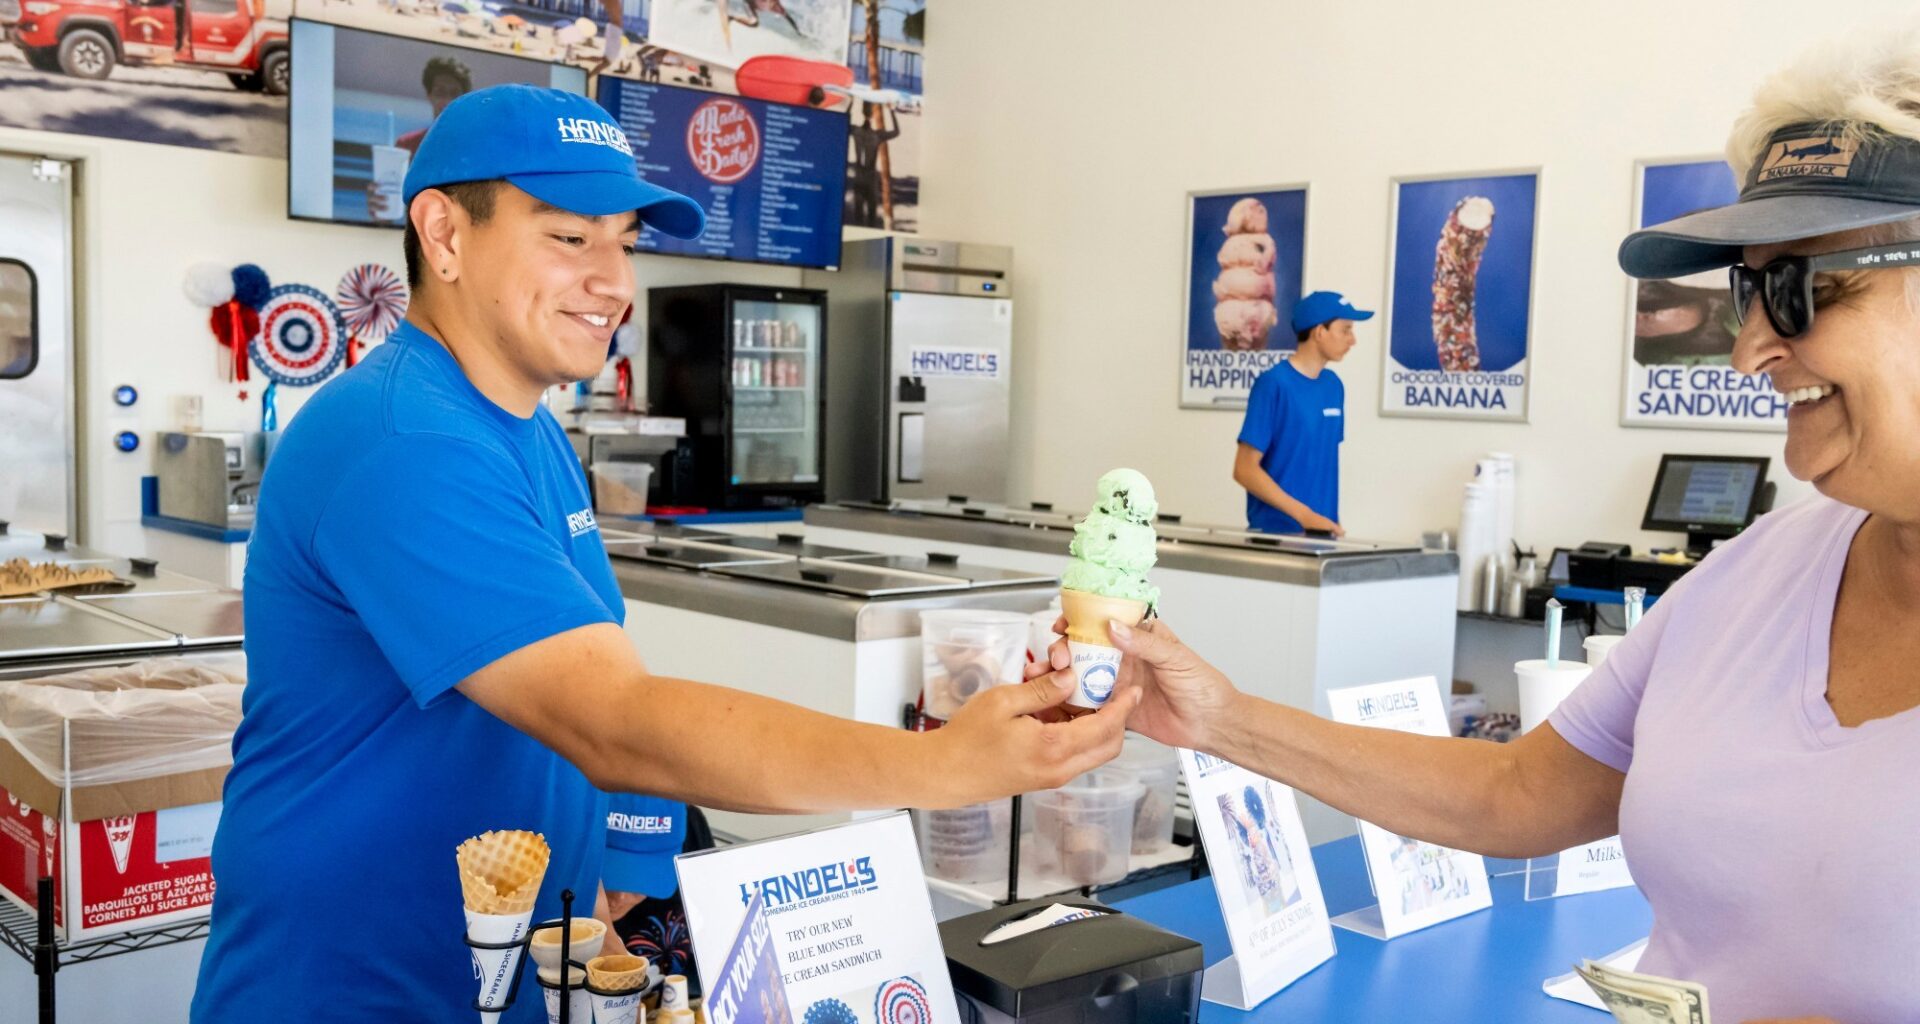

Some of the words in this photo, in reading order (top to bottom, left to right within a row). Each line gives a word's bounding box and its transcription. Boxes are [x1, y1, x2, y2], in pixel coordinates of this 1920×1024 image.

[1189, 352, 1234, 367] HAND
[1239, 352, 1294, 368] PACKE
[1391, 371, 1462, 385] CHOCOLATE
[1465, 374, 1525, 386] COVERED
[1648, 369, 1683, 390] ICE
[1405, 386, 1507, 409] BANANA
[1638, 391, 1789, 418] SANDWICH
[1585, 846, 1625, 863] Milks
[123, 879, 171, 897] JACKETED
[174, 872, 207, 888] SUGAR
[84, 894, 148, 915] BARQUILLOS
[151, 891, 163, 902] DE
[798, 899, 808, 909] ICE
[808, 895, 831, 907] CREAM
[831, 890, 849, 901] SINCE
[850, 886, 866, 897] 1945
[88, 906, 136, 925] CORNETS
[140, 904, 154, 915] AU
[157, 897, 188, 911] SUCRE
[786, 926, 806, 942] TRY
[808, 921, 831, 937] OUR
[831, 914, 853, 931] NEW
[788, 946, 816, 963] BLUE
[817, 934, 864, 956] MONSTER
[793, 963, 830, 982] CREAM
[831, 948, 882, 972] SANDWICH
